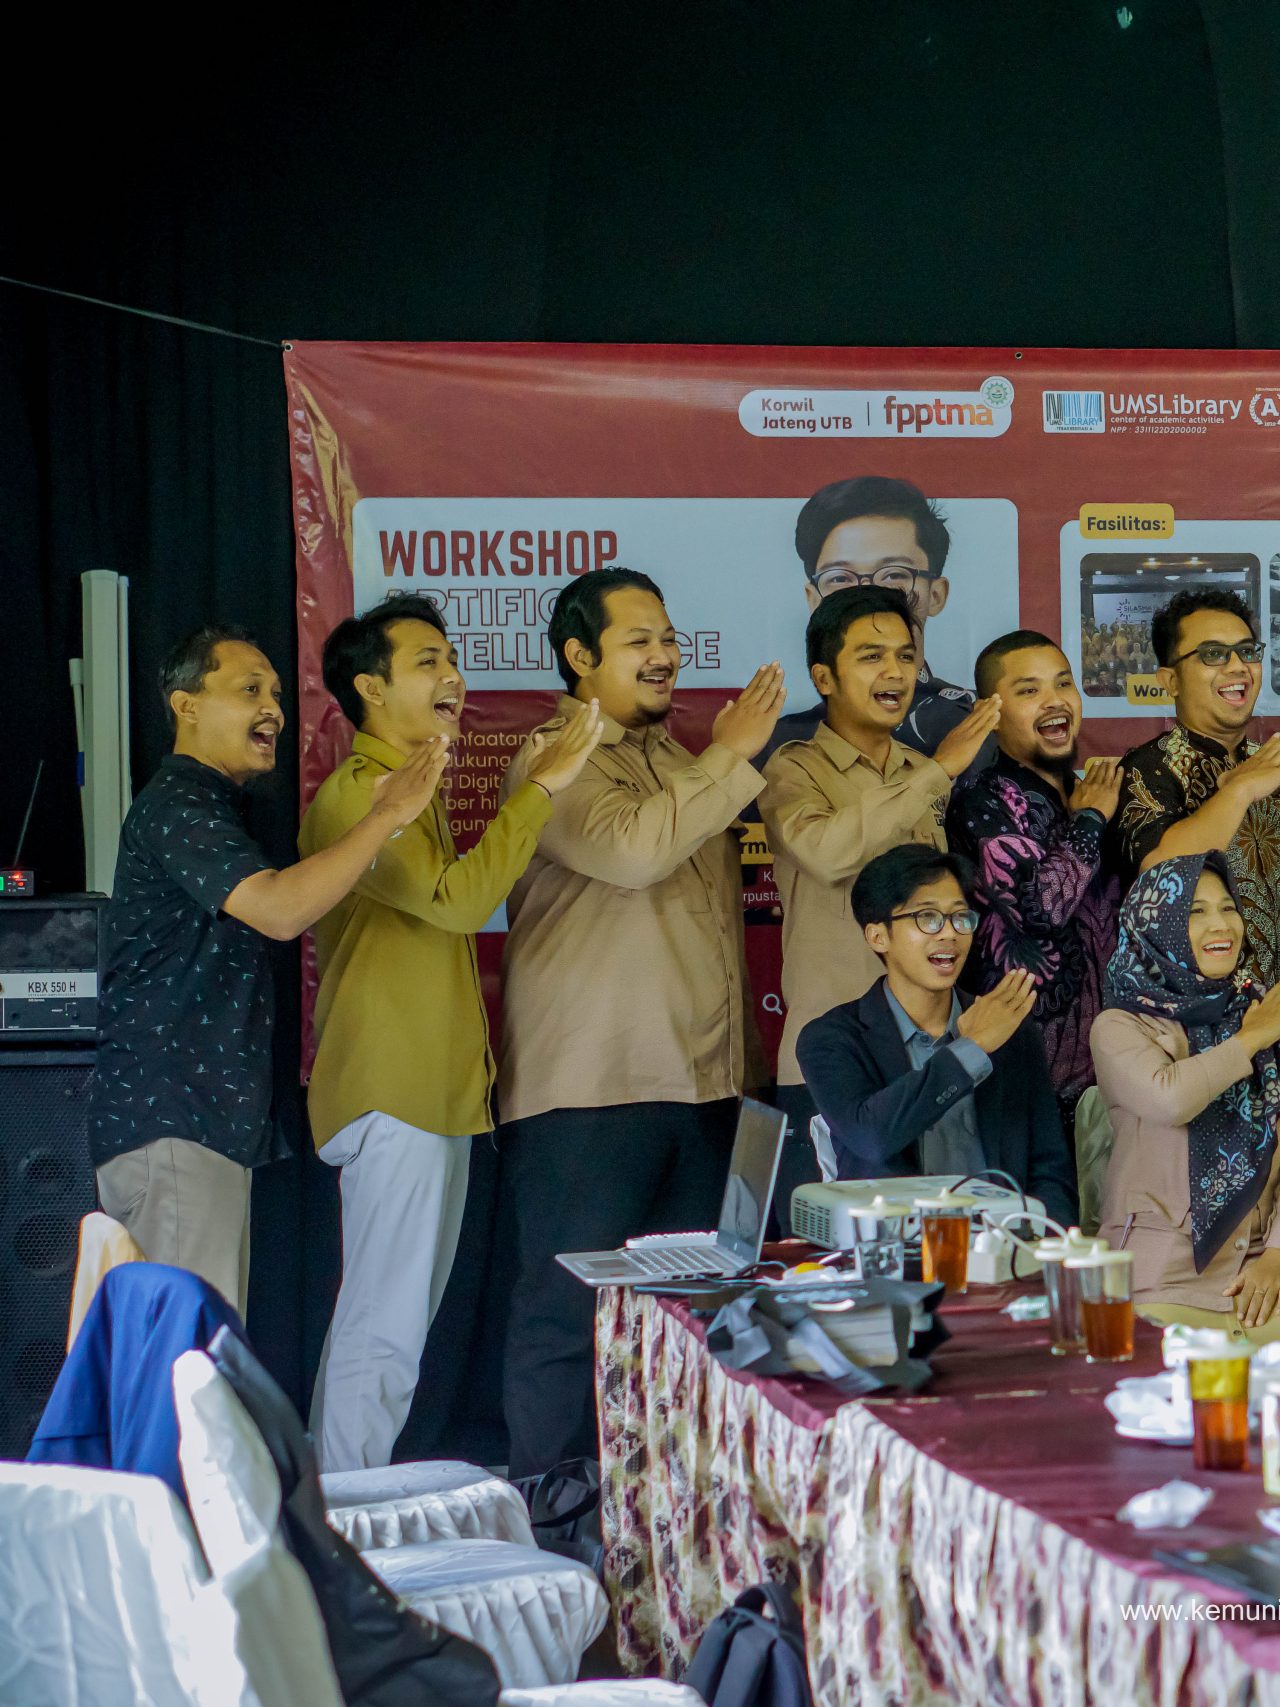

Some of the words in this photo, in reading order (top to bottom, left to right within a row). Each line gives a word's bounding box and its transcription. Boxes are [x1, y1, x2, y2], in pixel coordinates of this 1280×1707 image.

[761, 398, 815, 412] Korwil
[1109, 393, 1243, 420] UMSLibrary
[1260, 398, 1280, 417] A
[883, 395, 994, 434] fpptma
[1063, 417, 1099, 426] LIBRARY
[1110, 416, 1136, 424] center
[1139, 415, 1147, 424] of
[1149, 415, 1186, 424] academic
[1188, 415, 1225, 424] activities
[761, 416, 817, 433] Jateng
[820, 416, 853, 430] UTB
[1087, 515, 1167, 532] Fasilitas:
[379, 530, 618, 577] WORKSHOP
[459, 773, 505, 793] Digit
[445, 795, 476, 810] ber
[28, 981, 48, 993] KBX
[51, 981, 67, 993] 550
[69, 981, 76, 993] H
